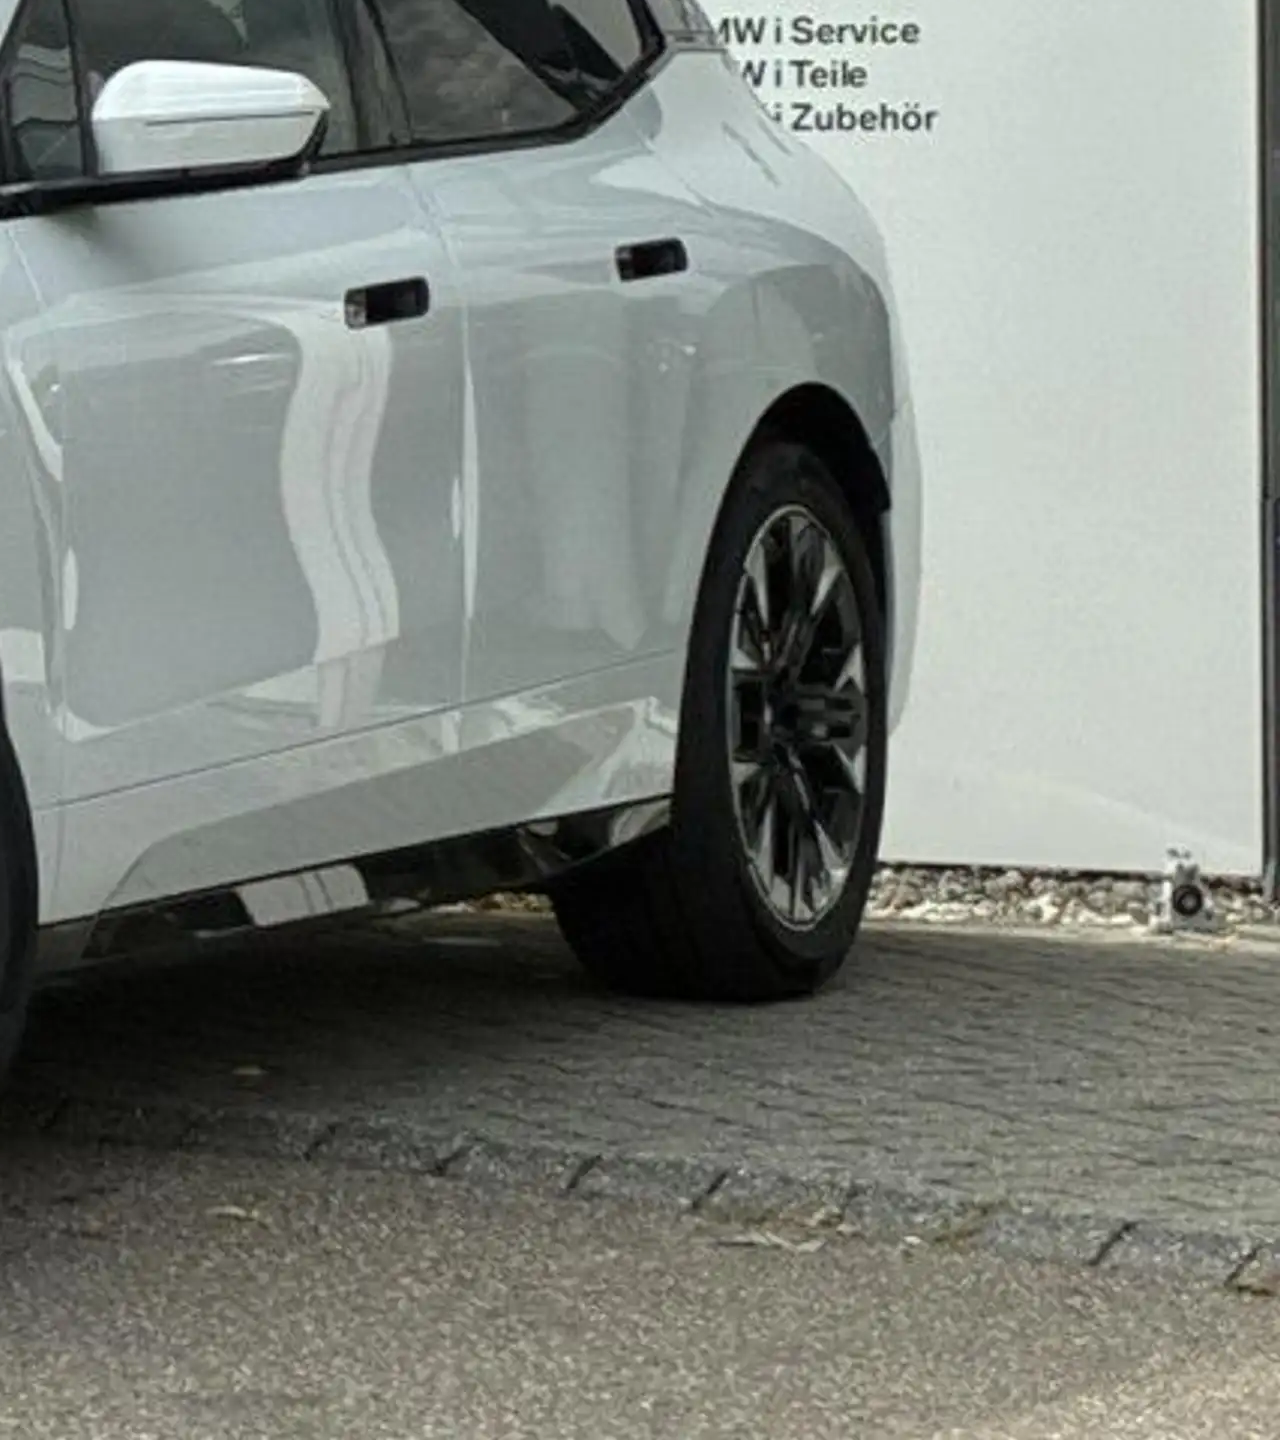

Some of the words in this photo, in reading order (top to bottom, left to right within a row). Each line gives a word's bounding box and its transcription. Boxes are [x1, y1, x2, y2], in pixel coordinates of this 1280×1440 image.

[773, 16, 783, 45] i
[789, 14, 921, 46] Service
[773, 58, 783, 89] i
[787, 58, 869, 89] Teile
[790, 101, 940, 133] Zubehör
